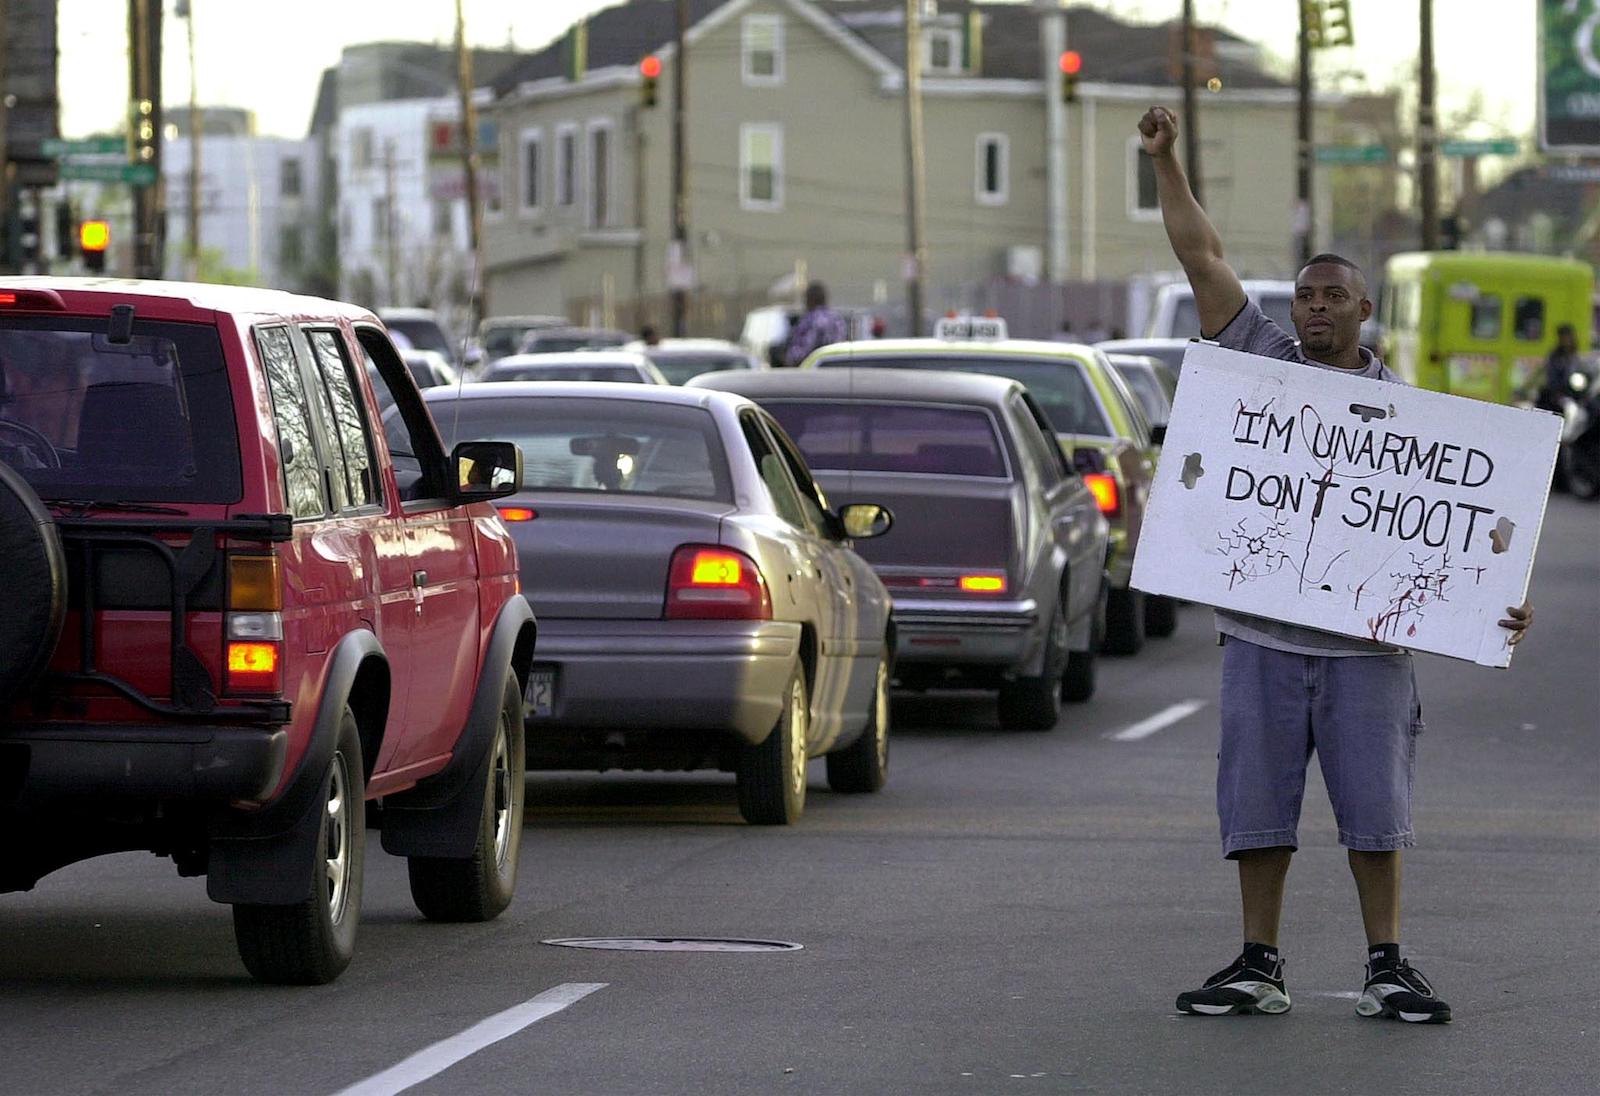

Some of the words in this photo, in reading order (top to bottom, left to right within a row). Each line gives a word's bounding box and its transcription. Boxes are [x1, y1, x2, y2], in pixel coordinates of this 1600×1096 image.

[1312, 422, 1495, 488] UNARMED
[1225, 466, 1341, 519] DON'T
[1341, 486, 1496, 553] SHOOT
